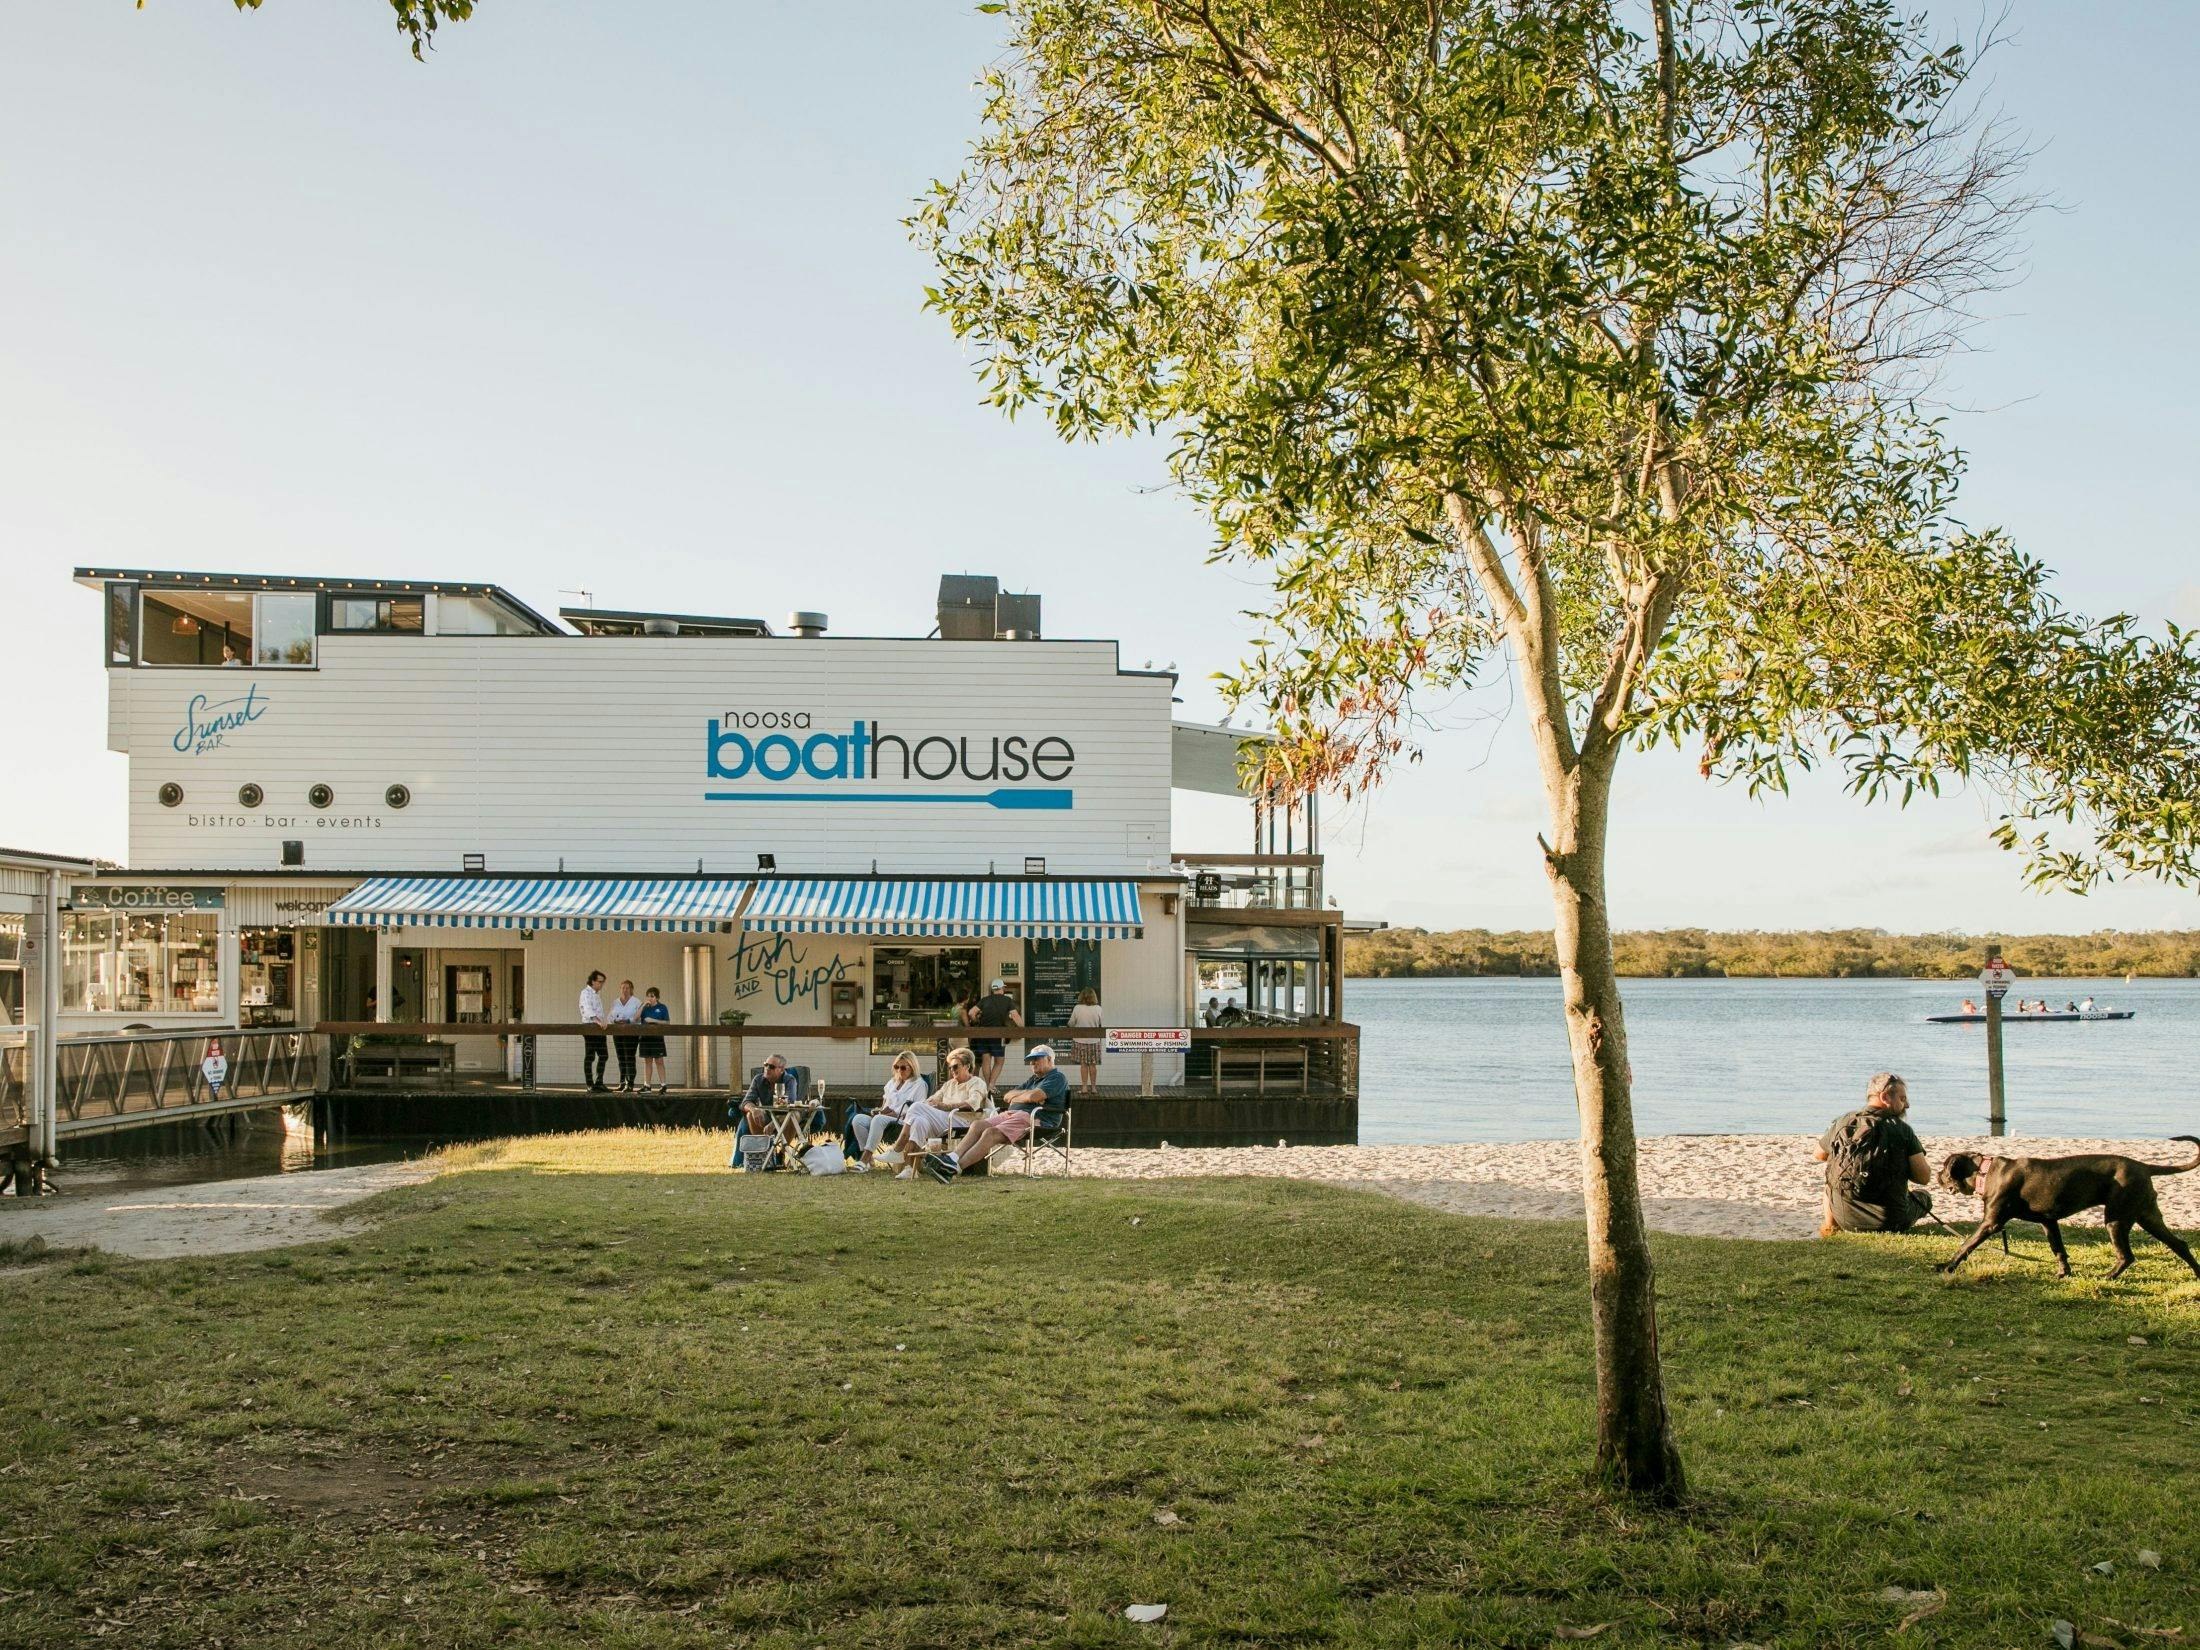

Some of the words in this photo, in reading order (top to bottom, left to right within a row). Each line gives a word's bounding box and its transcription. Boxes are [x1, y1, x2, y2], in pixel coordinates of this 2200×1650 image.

[174, 683, 270, 752] Sunset
[724, 711, 811, 729] noosa
[196, 734, 231, 755] BAR
[707, 719, 1075, 781] boathouse
[188, 814, 246, 827] bistro
[265, 814, 296, 827] bar
[316, 815, 381, 828] events
[108, 886, 195, 907] Coffee
[275, 900, 334, 911] welcom
[734, 980, 760, 996] AND
[764, 953, 856, 1010] Chips
